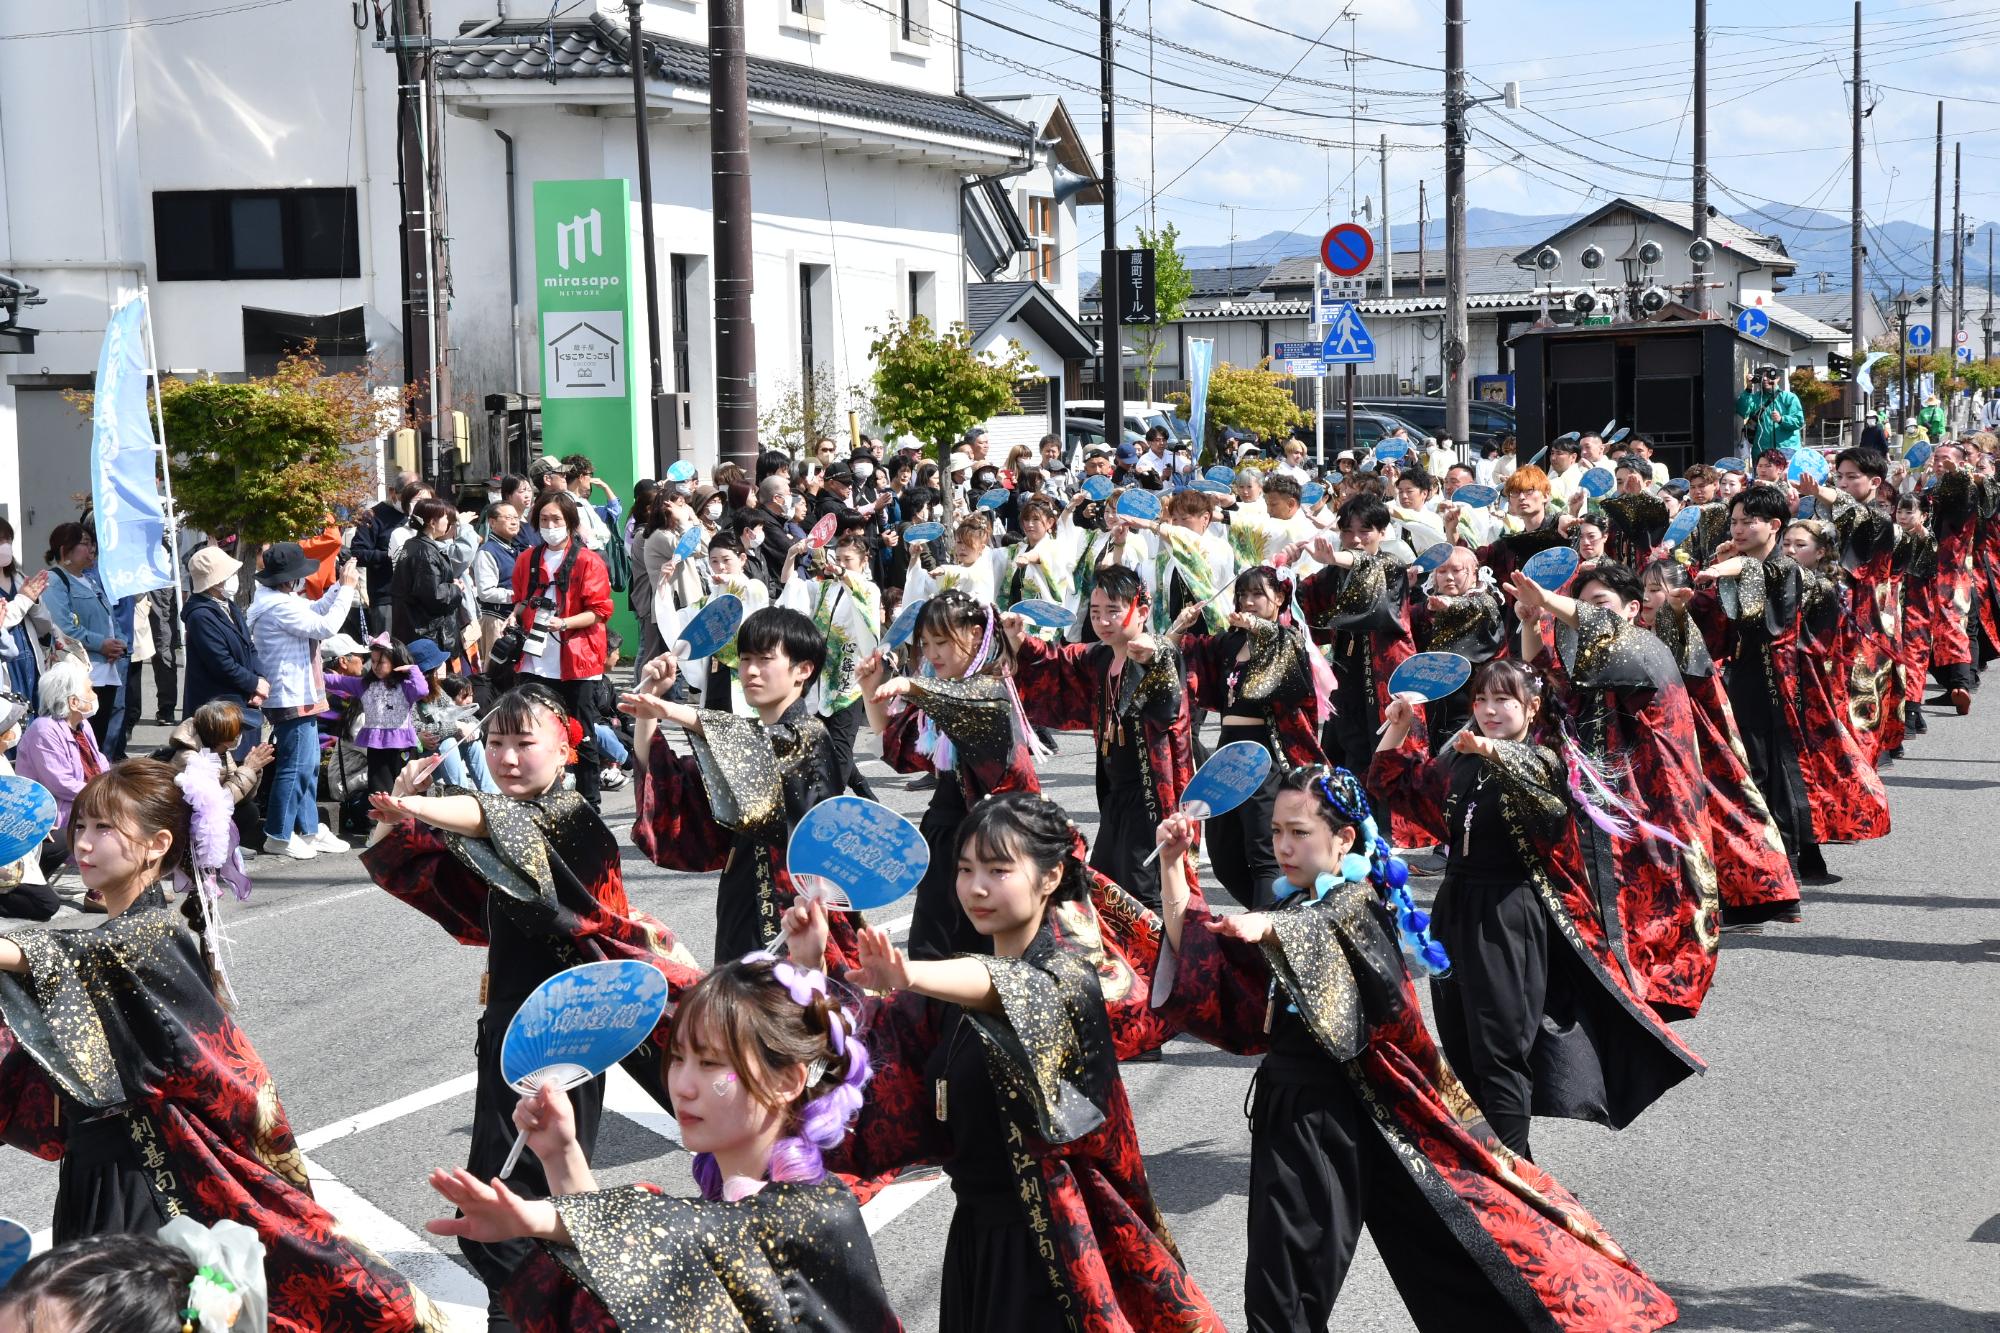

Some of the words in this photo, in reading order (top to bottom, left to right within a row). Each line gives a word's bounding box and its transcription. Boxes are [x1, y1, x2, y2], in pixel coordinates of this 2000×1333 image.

[544, 274, 620, 290] mirasapo
[1130, 252, 1144, 312] 蔵町モール
[1332, 280, 1362, 289] 自動車
[122, 1108, 189, 1218] 刺甚句ま
